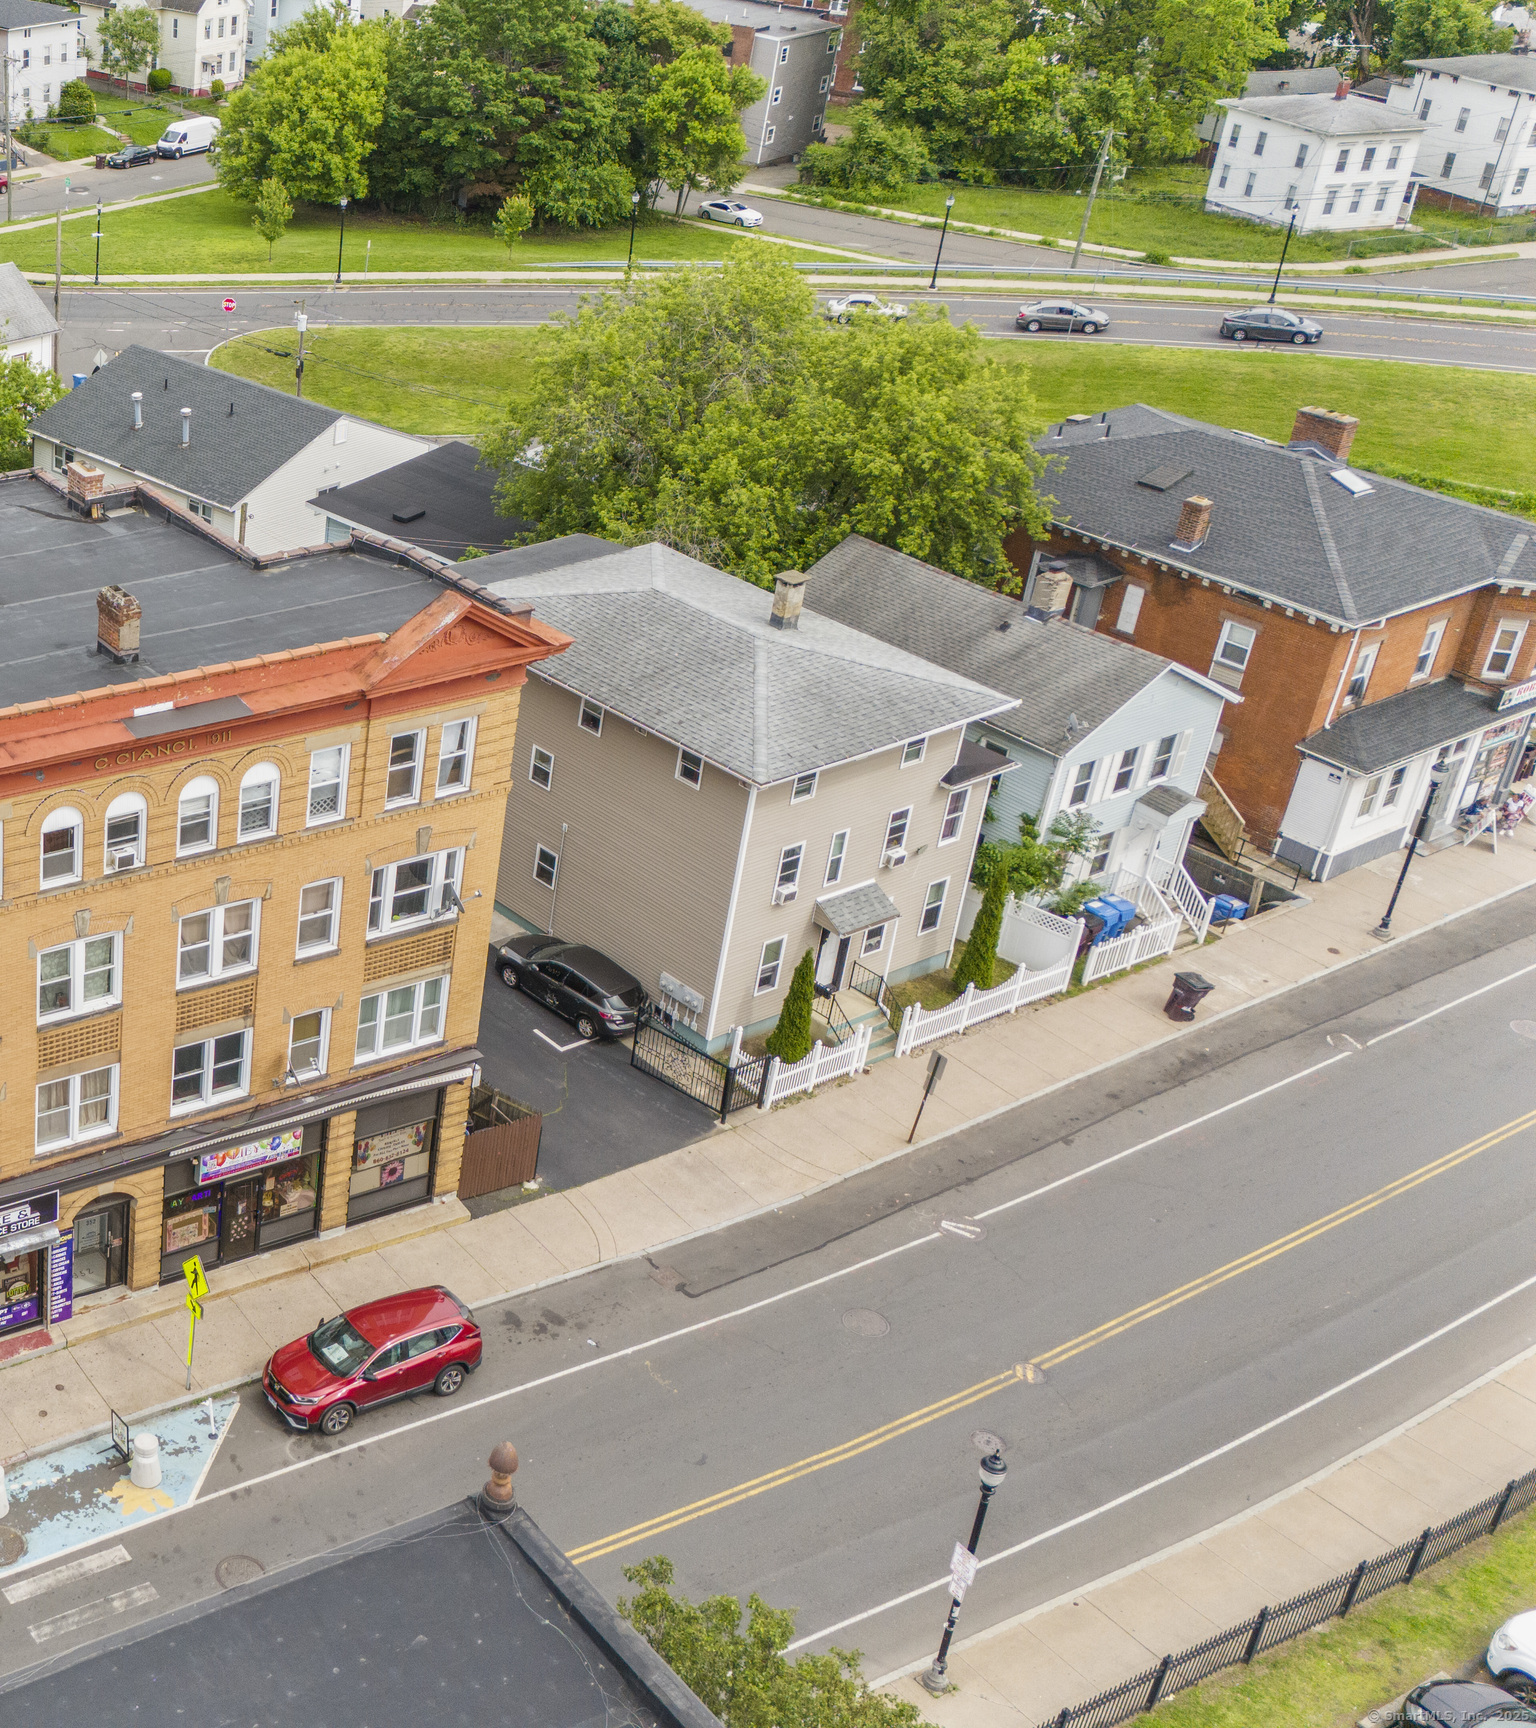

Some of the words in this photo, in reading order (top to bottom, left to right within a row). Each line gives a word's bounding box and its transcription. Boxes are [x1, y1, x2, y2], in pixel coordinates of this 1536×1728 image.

[94, 757, 112, 771] C.
[205, 729, 232, 746] 1911
[17, 1209, 29, 1220] &
[10, 1216, 41, 1234] STORE
[6, 1283, 30, 1298] LOTTERY
